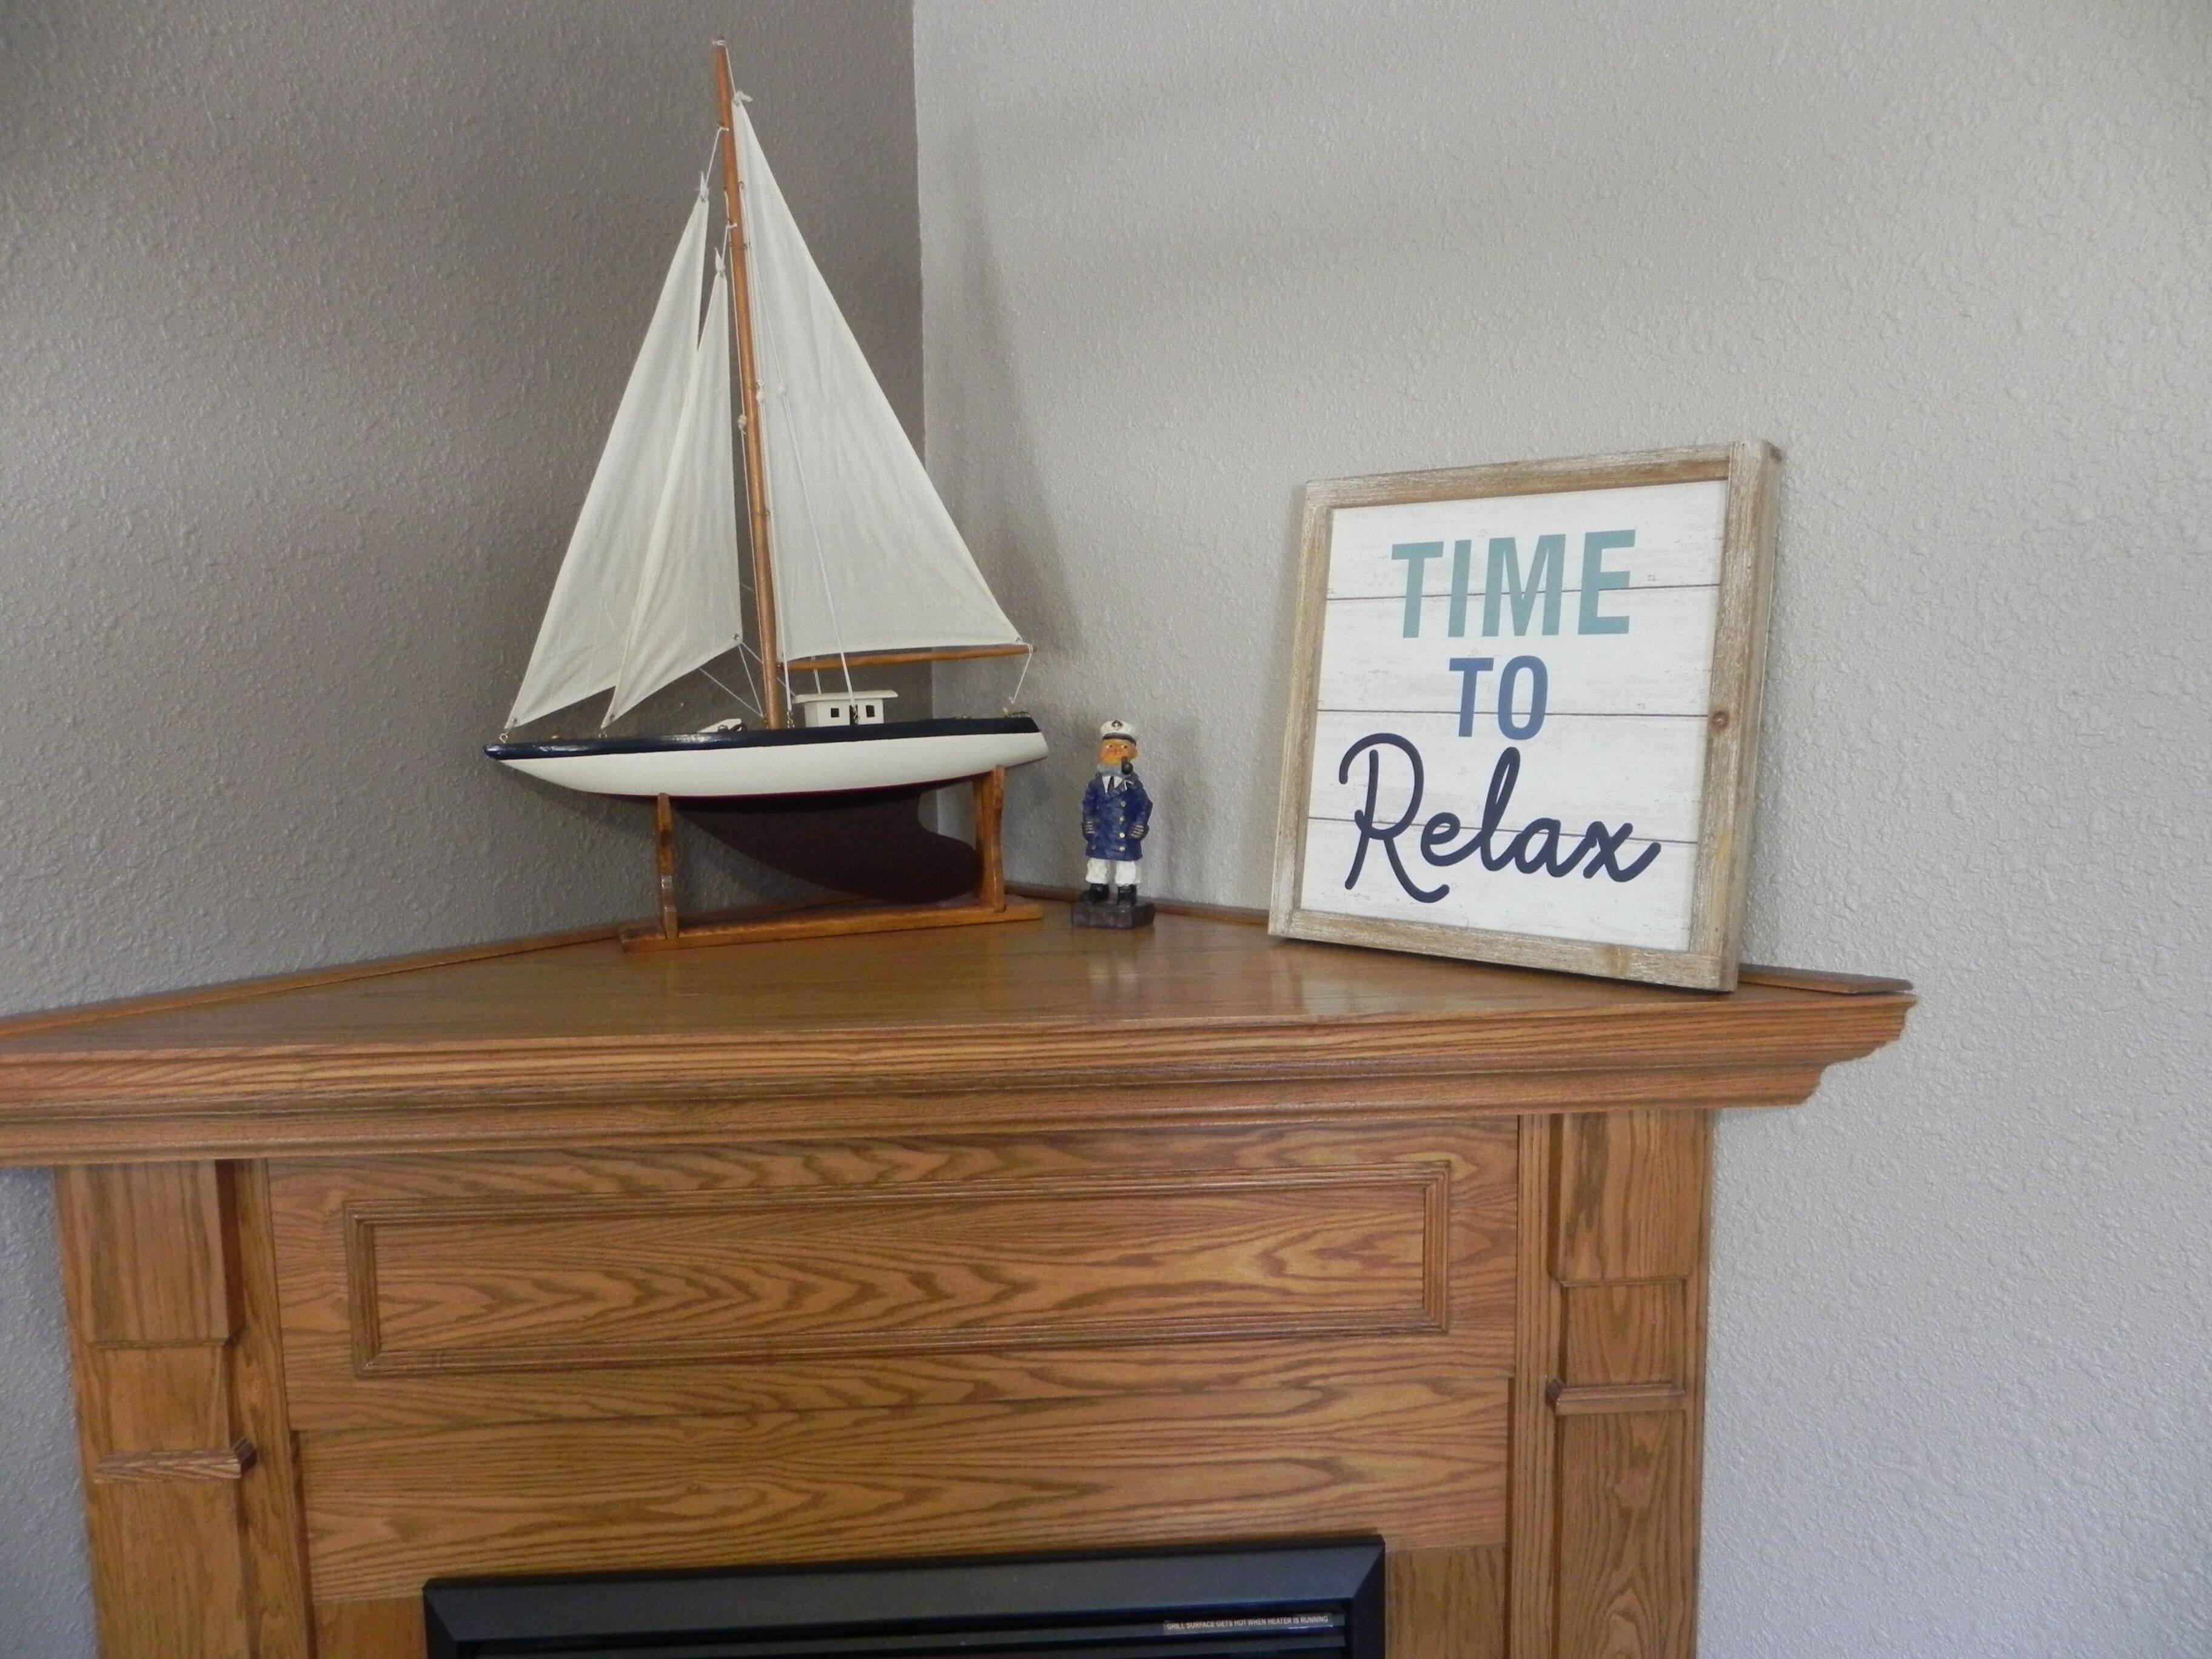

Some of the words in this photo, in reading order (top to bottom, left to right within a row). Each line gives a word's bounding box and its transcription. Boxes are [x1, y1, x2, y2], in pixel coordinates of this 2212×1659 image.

[1391, 529, 1637, 638] TIME
[1449, 655, 1549, 740] TO
[1338, 732, 1661, 903] Relax
[1186, 1621, 1215, 1629] SURFACE
